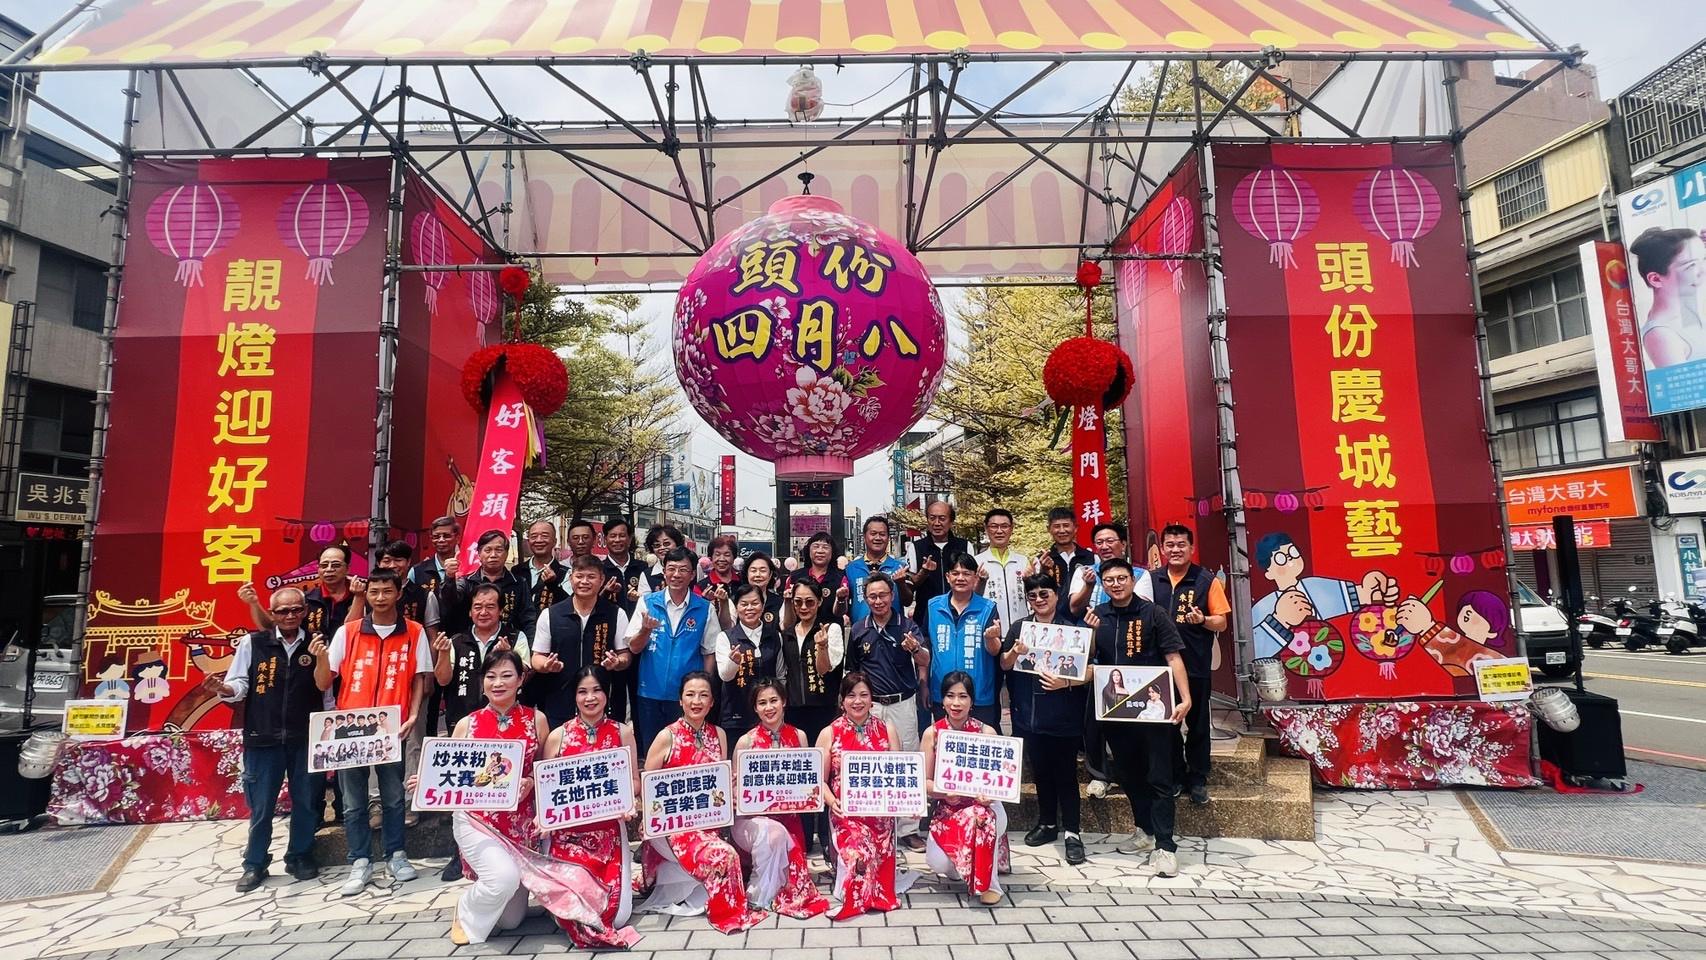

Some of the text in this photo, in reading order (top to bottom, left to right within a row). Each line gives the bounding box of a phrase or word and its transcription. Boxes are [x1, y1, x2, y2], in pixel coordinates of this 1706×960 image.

[733, 240, 892, 294] 頭份
[713, 300, 918, 372] 四月八
[1616, 299, 1642, 393] 台灣大哥大
[1315, 242, 1402, 557] 頭份慶城藝
[201, 259, 282, 584] 靚燈迎好客
[1078, 405, 1104, 526] 燈門拜
[1509, 480, 1608, 505] 台灣大哥大
[1528, 504, 1567, 516] myfone
[432, 750, 487, 767] 炒米粉
[945, 740, 1014, 760] 校園主題花燈
[749, 759, 812, 773] 校園青年爐主
[848, 762, 917, 774] 四月八燈樓下
[955, 755, 1001, 772] 創意競賽
[438, 770, 476, 787] 大賽
[559, 762, 609, 786] 慶城藝
[743, 772, 818, 787] 創意供桌迎媽祖
[849, 776, 918, 788] 客家藝文展演
[551, 779, 618, 806] 在地市集
[655, 774, 717, 798] 食飽聽歌
[425, 788, 463, 805] 5/11
[663, 793, 709, 814] 音樂會
[743, 790, 774, 803] 5/15
[546, 804, 581, 825] 5/11
[651, 815, 683, 833] 5/11
